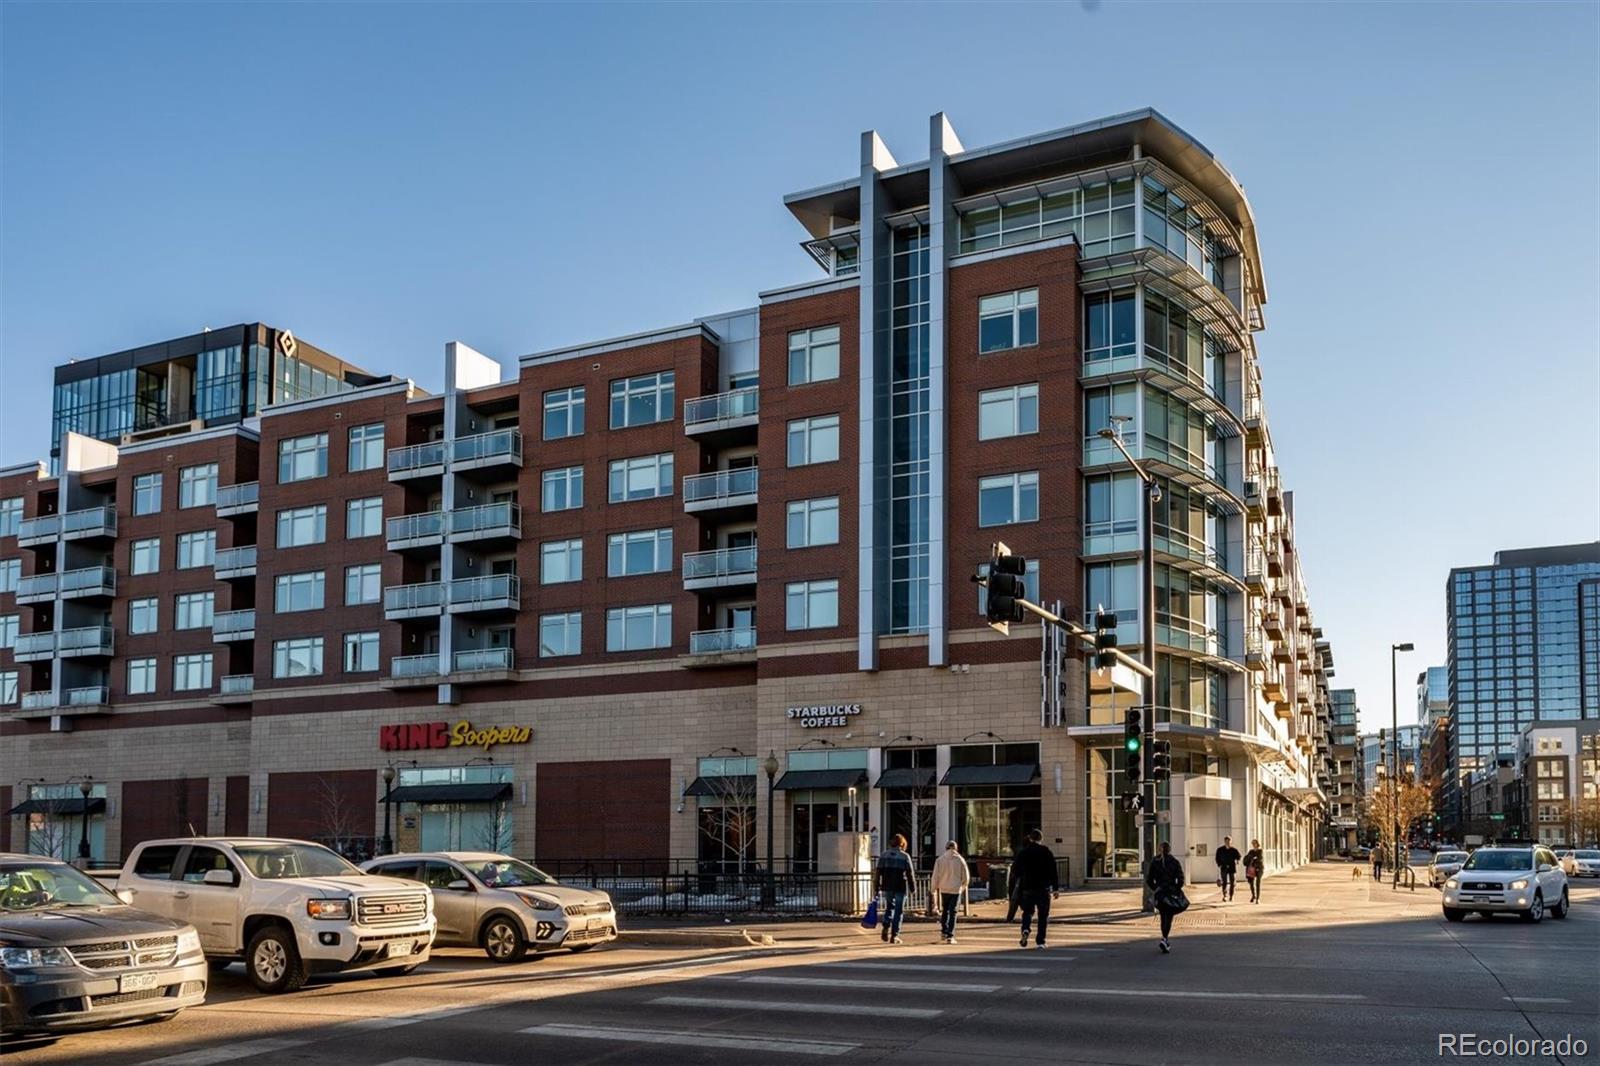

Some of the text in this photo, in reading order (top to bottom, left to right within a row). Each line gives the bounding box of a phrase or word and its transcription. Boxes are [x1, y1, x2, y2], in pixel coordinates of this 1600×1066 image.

[787, 704, 861, 718] STARBUCKS
[800, 716, 847, 728] COFFEE
[380, 719, 533, 751] KING Soopers
